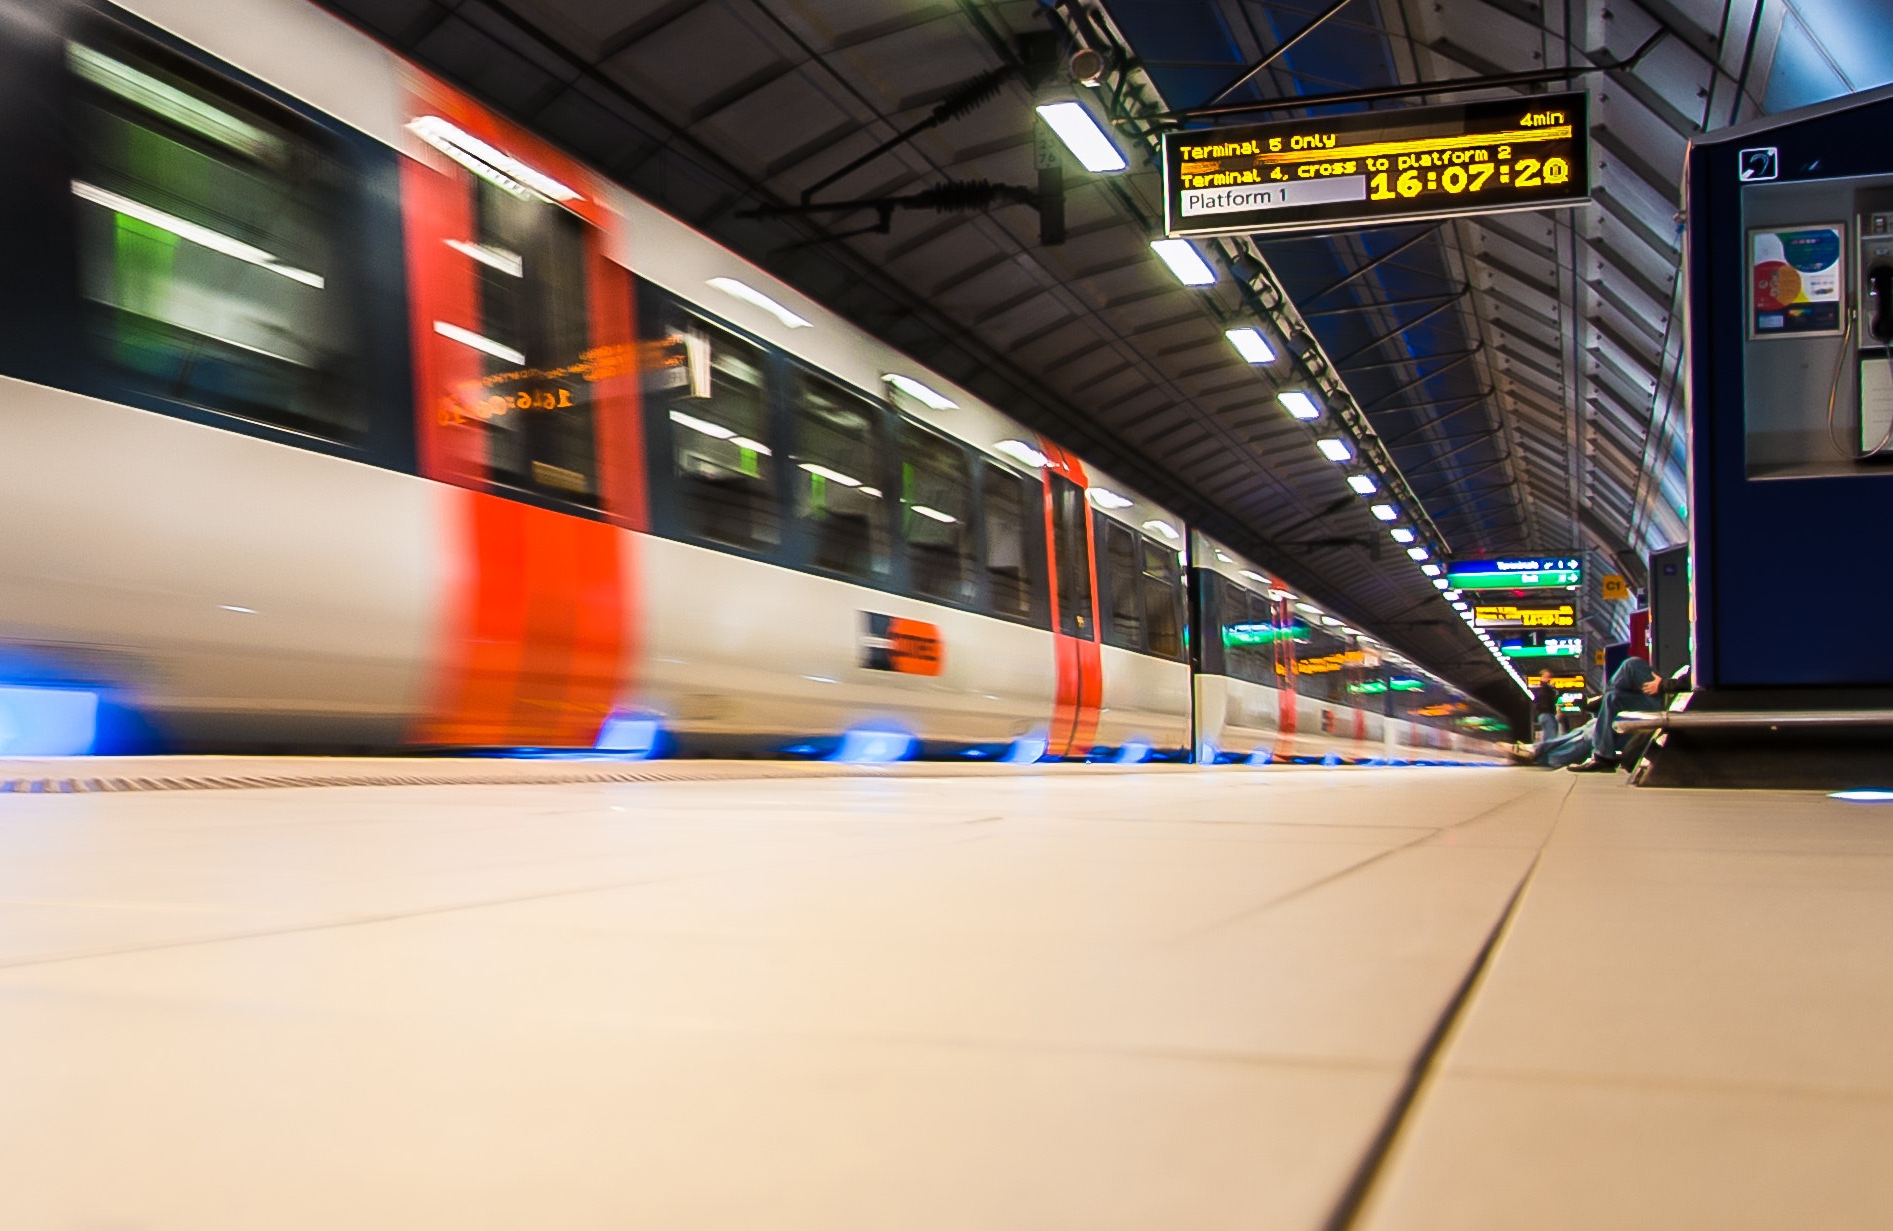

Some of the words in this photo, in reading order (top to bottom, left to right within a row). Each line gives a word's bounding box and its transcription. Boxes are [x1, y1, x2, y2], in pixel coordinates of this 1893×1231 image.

[1180, 140, 1260, 160] Terminal
[1268, 137, 1282, 151] 5
[1290, 133, 1336, 150] Only
[1520, 111, 1565, 127] 4min
[1181, 169, 1261, 189] Terminal
[1270, 166, 1289, 181] 4,
[1297, 160, 1357, 178] cross
[1366, 157, 1389, 172] to
[1398, 149, 1489, 170] platform
[1497, 145, 1512, 160] 2
[1370, 157, 1569, 201] 16:07:20
[1189, 190, 1271, 210] Platform
[1279, 188, 1287, 202] 1
[1606, 581, 1621, 591] C1
